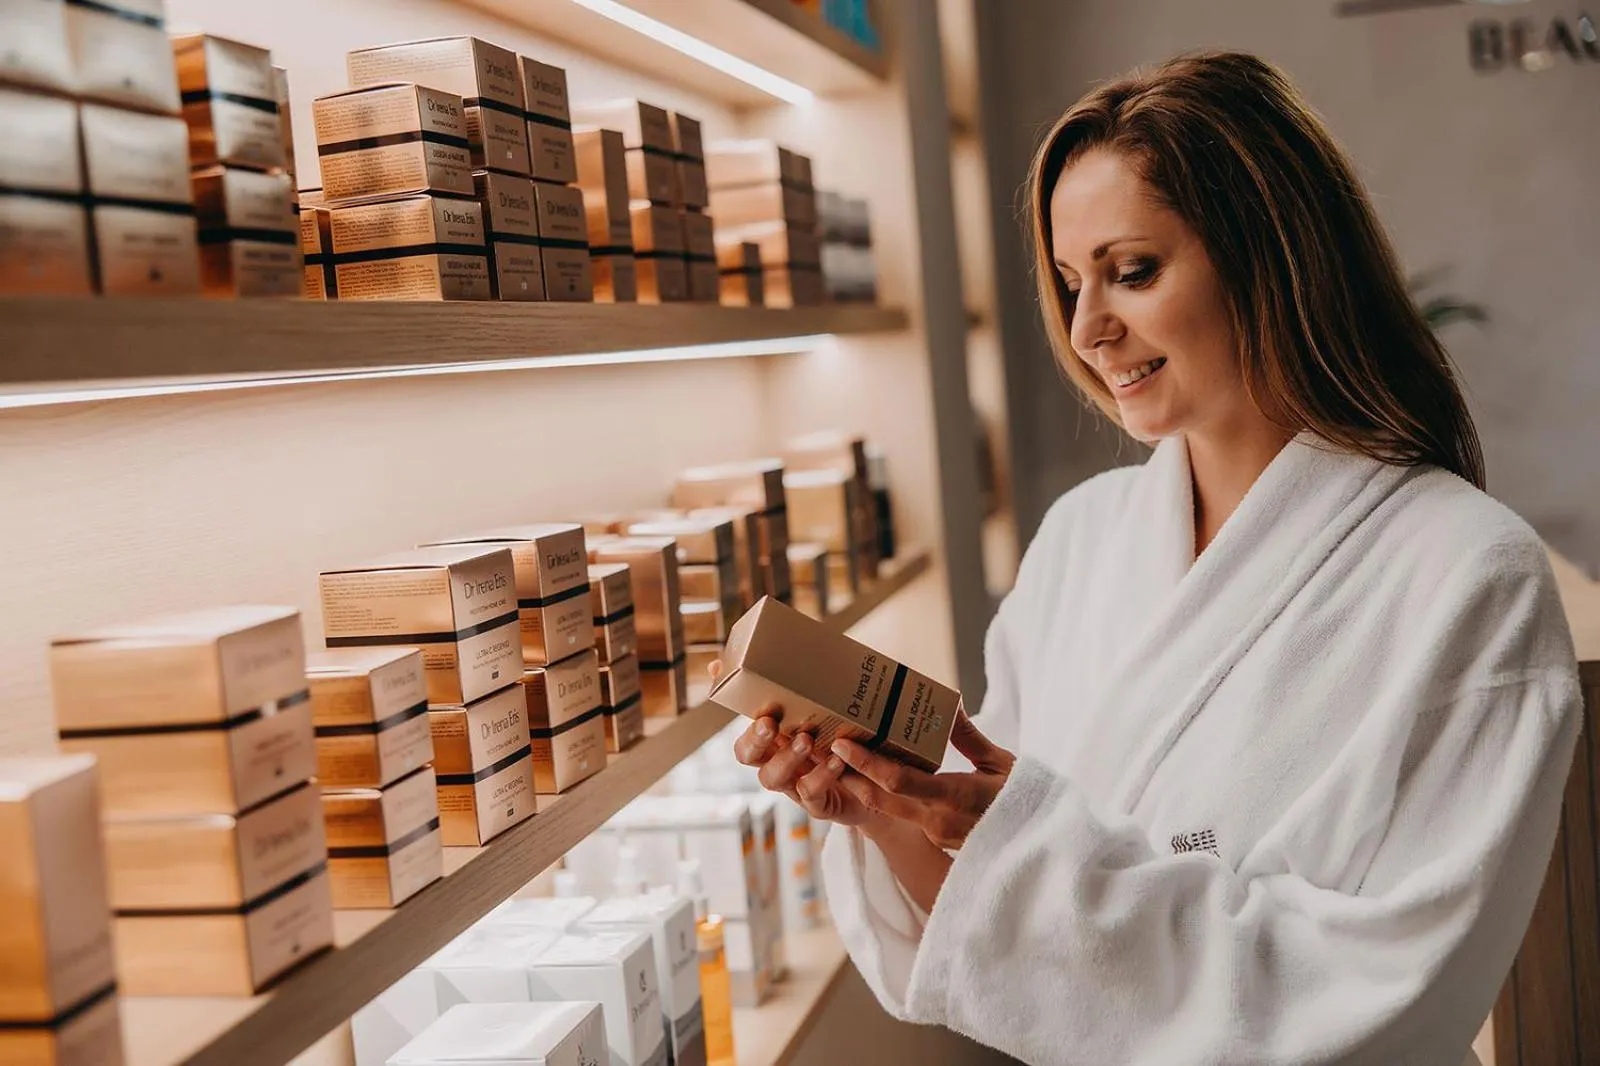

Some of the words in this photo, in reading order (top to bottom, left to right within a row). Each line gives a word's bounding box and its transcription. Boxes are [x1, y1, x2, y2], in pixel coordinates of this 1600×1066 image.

[464, 582, 474, 599] Dr
[475, 579, 494, 595] Irena
[494, 572, 507, 590] Eris
[862, 654, 876, 673] Eris
[852, 674, 871, 702] Irena
[848, 701, 861, 718] Dr
[904, 716, 916, 740] AQUA
[910, 682, 926, 717] IDEALINE
[480, 723, 491, 740] Dr
[492, 718, 509, 734] Irena
[508, 708, 520, 726] Eris
